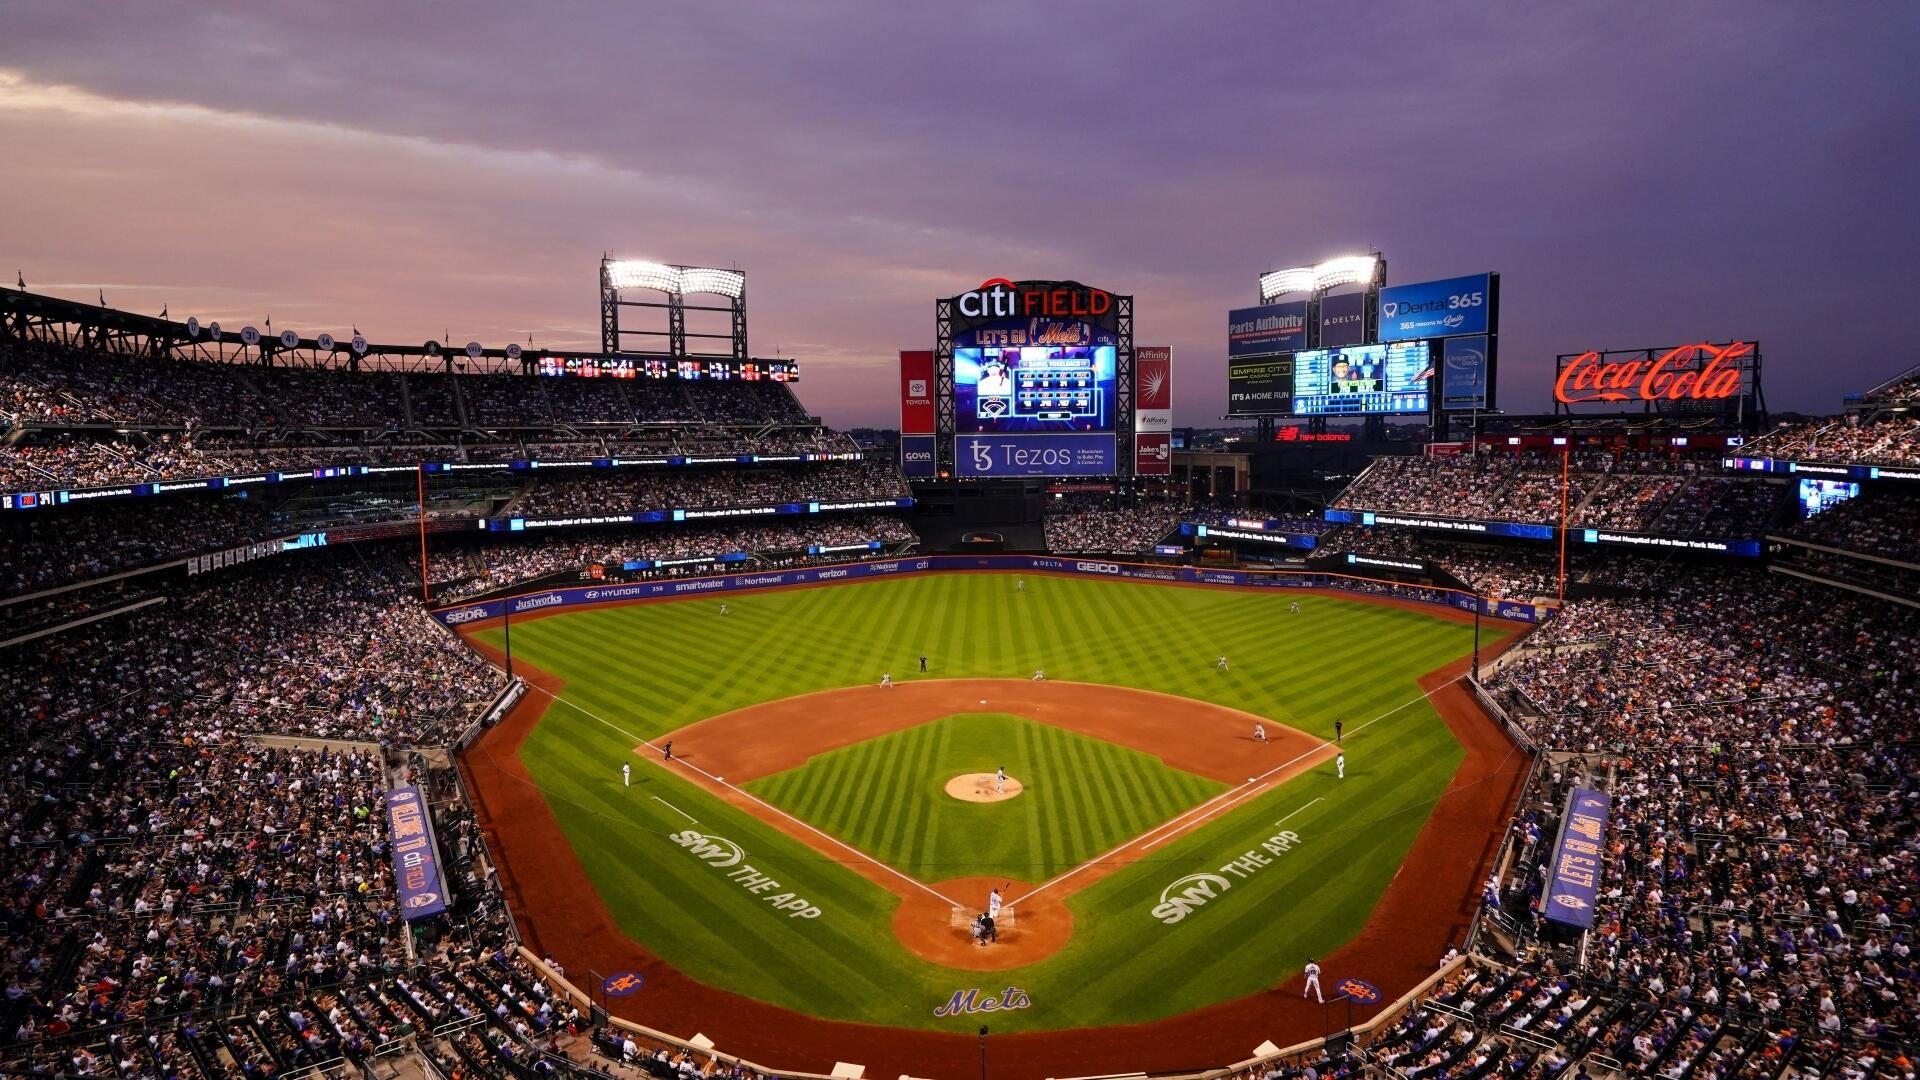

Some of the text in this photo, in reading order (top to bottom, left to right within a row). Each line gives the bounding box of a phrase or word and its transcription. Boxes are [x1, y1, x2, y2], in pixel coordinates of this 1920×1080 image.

[959, 284, 1111, 317] citi FIELD
[1230, 321, 1254, 334] Parts
[1256, 315, 1303, 332] Authority
[1332, 315, 1360, 324] DELTA
[1400, 321, 1414, 330] 365
[246, 331, 256, 341] 31
[286, 335, 295, 343] 41
[976, 322, 1082, 344] LET'S GO Mets
[354, 341, 364, 349] 37
[1139, 351, 1168, 360] Affinity
[1555, 342, 1754, 403] Coca-Cola
[1146, 416, 1168, 424] Affinity
[1001, 444, 1070, 466] Tezos
[3, 496, 12, 508] 12
[40, 493, 50, 505] 34
[1396, 518, 1420, 526] Hospital
[1077, 562, 1119, 573] GEICO
[744, 576, 781, 585] Northwell
[818, 570, 847, 579] verizon
[675, 580, 724, 591] smartwater
[601, 588, 640, 597] HYUNDAI
[516, 595, 562, 609] Justworks
[1503, 609, 1529, 618] Corona
[1566, 838, 1598, 855] GO
[403, 852, 424, 868] citi
[669, 830, 822, 919] SNY THE APP
[1558, 853, 1595, 888] LET'S
[405, 866, 426, 890] FIELD
[1151, 830, 1302, 924] SNY THE APP
[933, 987, 1031, 1017] Mets
